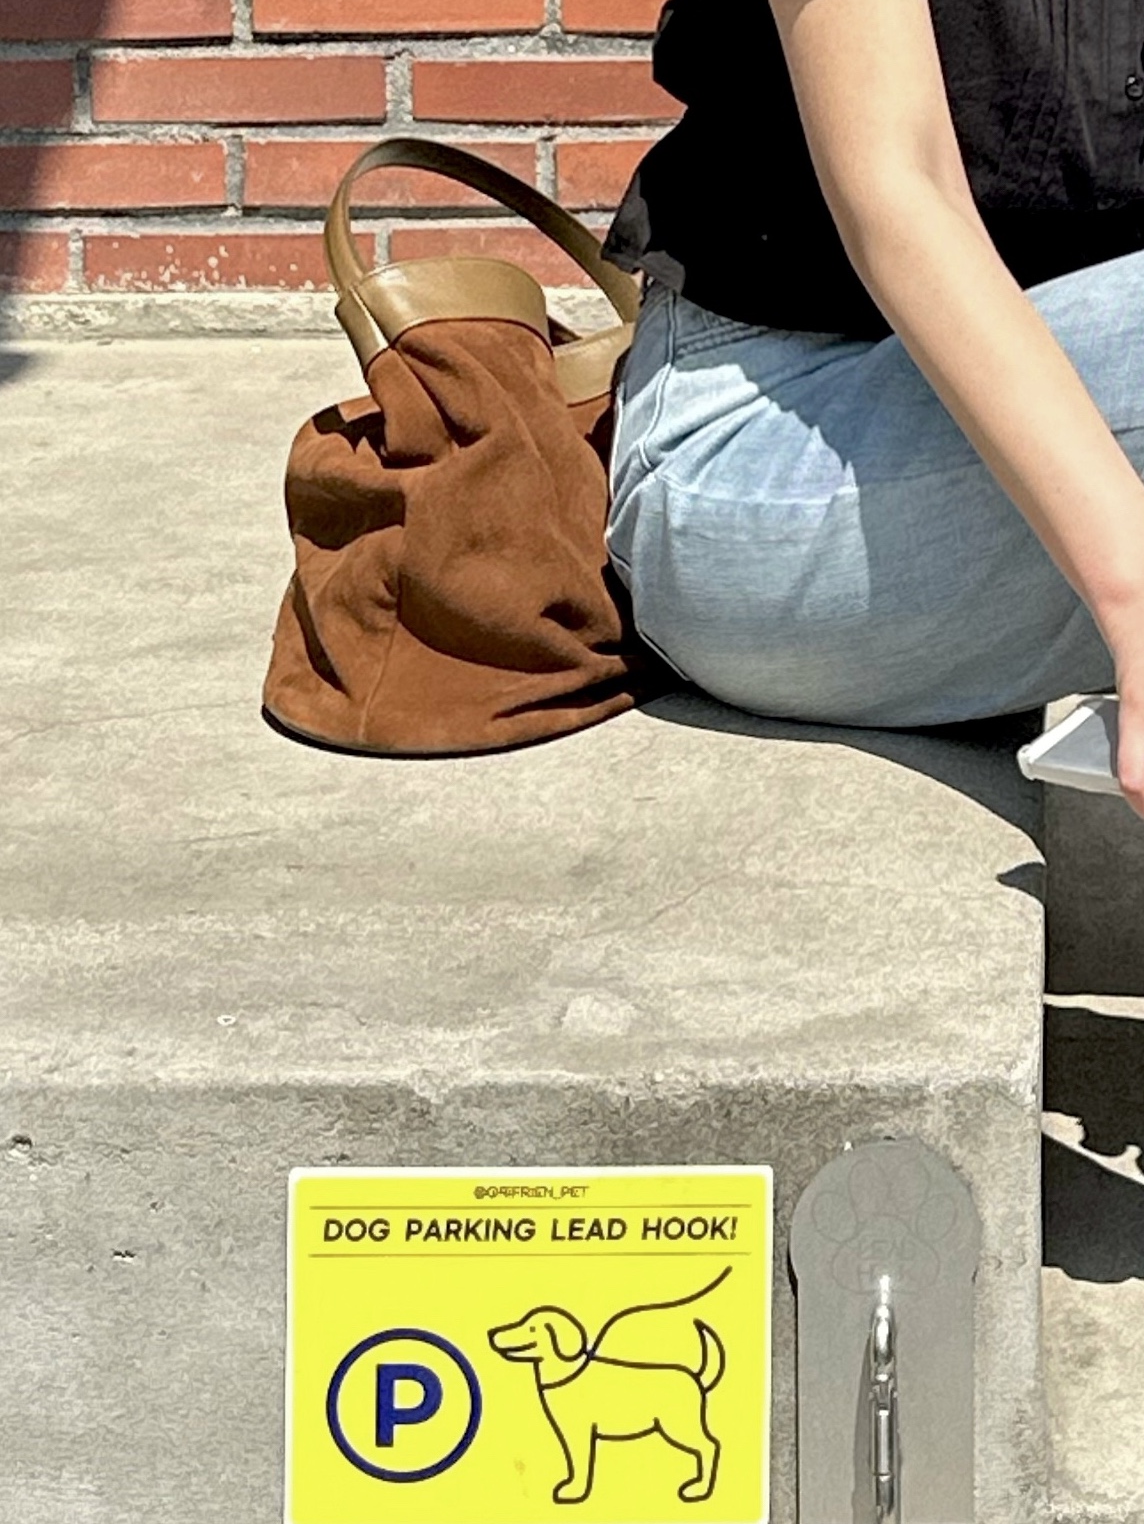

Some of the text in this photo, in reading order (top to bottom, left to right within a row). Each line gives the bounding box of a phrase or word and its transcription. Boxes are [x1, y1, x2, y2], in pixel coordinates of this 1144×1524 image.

[323, 1216, 739, 1242] DOG PARKING LEAD HOOK!
[375, 1363, 443, 1448] P
